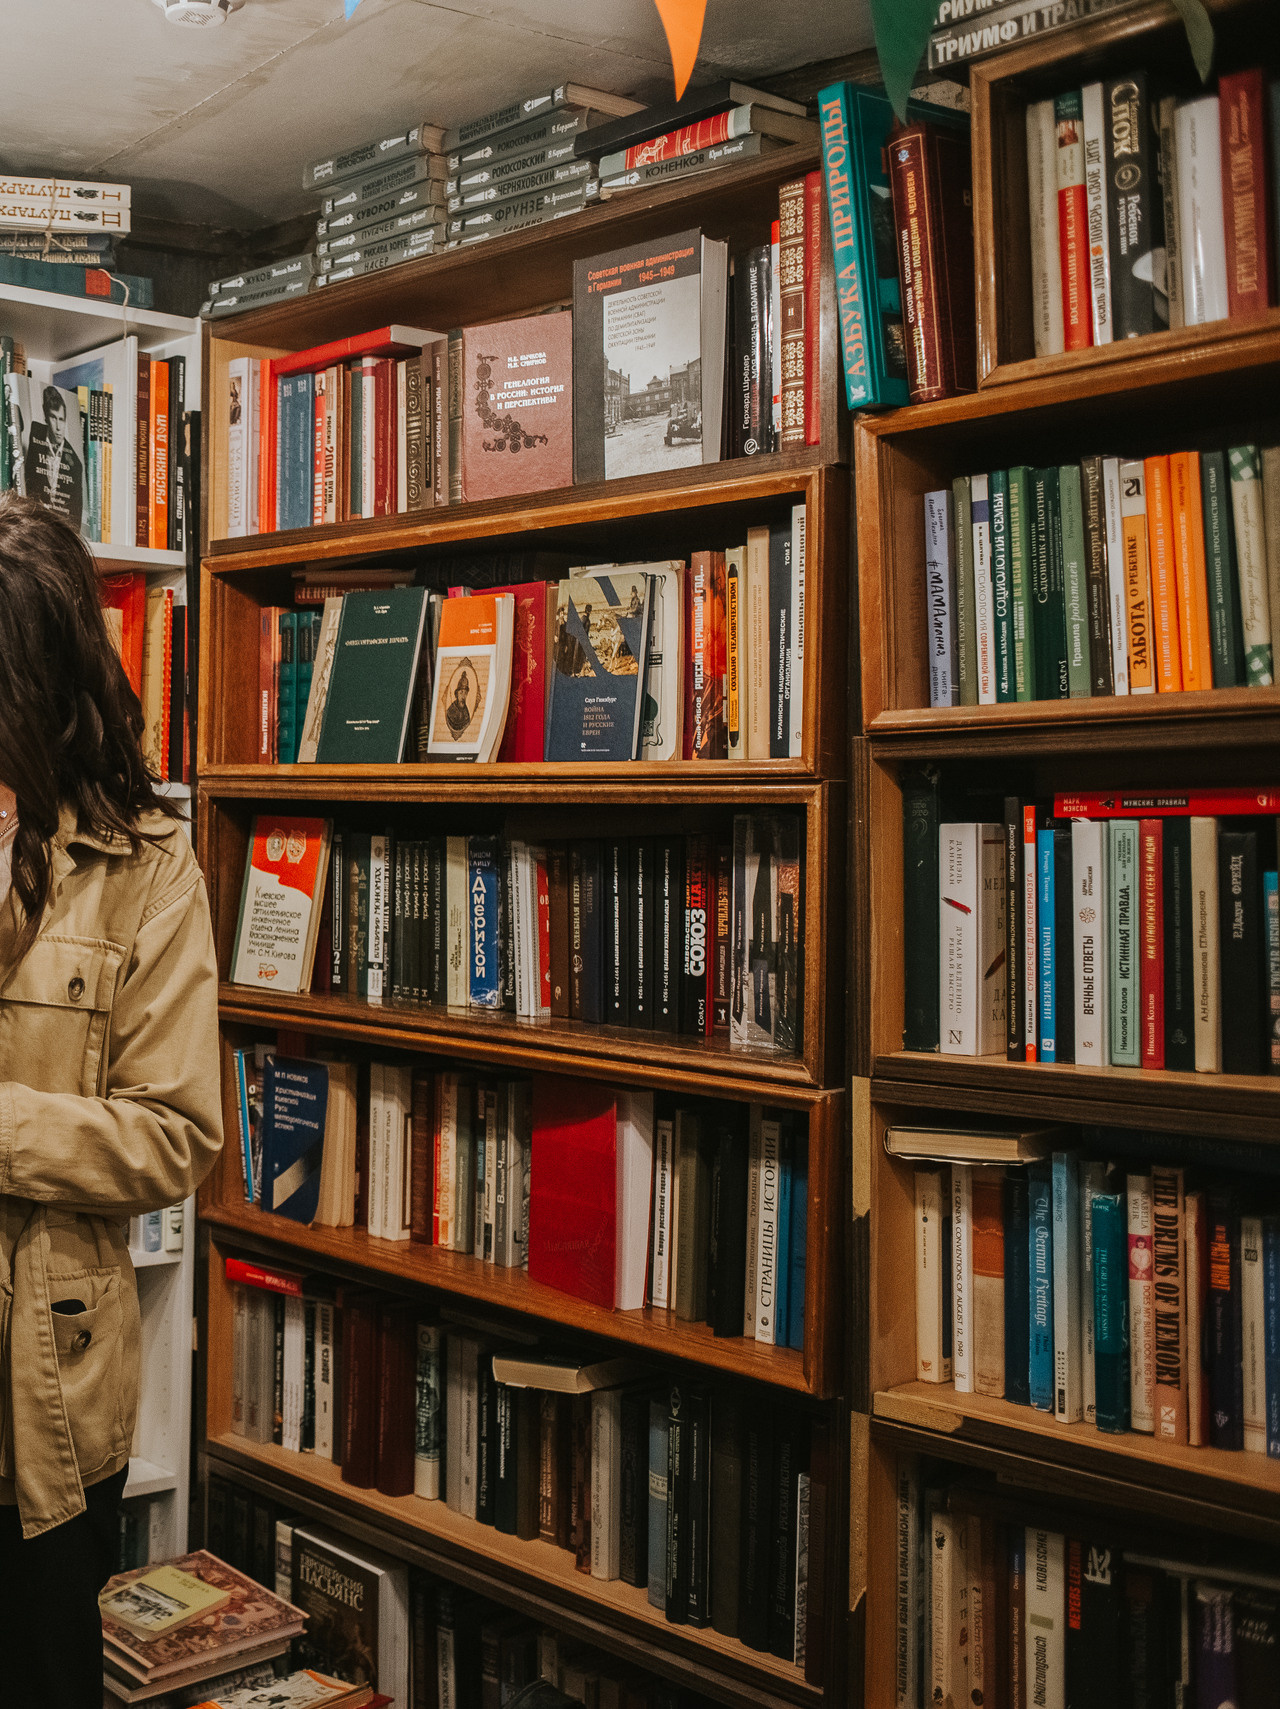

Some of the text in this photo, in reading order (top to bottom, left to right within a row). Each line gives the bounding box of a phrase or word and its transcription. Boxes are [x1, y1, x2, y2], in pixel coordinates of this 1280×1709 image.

[935, 15, 1036, 63] ТРИУМФ И
[492, 151, 546, 179] РОКОССОВСКИЙ
[497, 171, 556, 197] ЧЕРНЯХОВСКИЙ
[356, 199, 396, 221] СУВОРОВ
[494, 198, 544, 222] ФРУНЗЕ
[1065, 189, 1076, 239] ИСЛАМЕ
[822, 98, 866, 377] АЗБУКА ПРИРОДЫ
[245, 272, 271, 286] ЖУКОВ
[588, 247, 694, 281] Советская военная администрация
[900, 229, 916, 323] ОСНОВЫ ПСИХОЛОГИИ
[750, 267, 758, 313] ПОЛИТИКЕ
[1066, 252, 1079, 325] ВОСПИТАНИЕ
[750, 324, 758, 358] ЖИЗНЬ
[504, 376, 550, 389] ГЕНЕАЛОГИЯ
[750, 358, 758, 379] МОЯ
[490, 384, 564, 401] В РОССИИ: ИСТОРИЯ
[504, 395, 557, 409] ПЕРСПЕКТИВЫ
[740, 355, 751, 430] Герхард Шрёдер
[155, 414, 167, 504] РУССКИЙ ДОМ
[993, 493, 1008, 617] СОЦИОЛОГИЯ СЕМЬИ
[1208, 467, 1224, 604] ЖИЗНЕННОЕ ПРОСТРАНСТВО СЕМЬИ
[1068, 561, 1084, 667] Правила родителей
[1128, 536, 1147, 669] ЗАБОТА О РЕБЕНКЕ
[778, 609, 786, 693] НАЦИОНАЛИСТИЧЕСКИЕ
[977, 569, 989, 694] ПСИХОЛОГИЯ СОВРЕМЕННОЙ СЕМЬИ
[1145, 836, 1155, 864] ЛЮДЯМ
[374, 867, 382, 915] МОНОМАХ
[1146, 873, 1155, 890] СЕБЕ
[254, 900, 277, 908] высшее
[394, 892, 402, 916] триумф
[1146, 899, 1156, 943] ОТНОСИТЬСЯ
[251, 924, 300, 935] ордена Ленина
[690, 909, 705, 977] СОЮЗ
[1026, 872, 1034, 1034] Кавашина СУПЕРСЧЕТ ДЛЯ СУПЕРМОЗГА
[1043, 927, 1051, 1020] ПРАВИЛА ЖИЗНИ
[1147, 945, 1156, 959] КАК
[1083, 935, 1094, 1015] ВЕЧНЫЕ ОТВЕТЫ
[1146, 993, 1155, 1020] Козлов
[1146, 1022, 1155, 1055] Николай
[760, 1137, 776, 1307] СТРАНИЦЫ ИСТОРИИ
[954, 1196, 962, 1224] GENEVA
[1130, 1198, 1140, 1220] WEIR
[954, 1226, 962, 1281] CONVENTIONS
[956, 1282, 962, 1293] OF
[1153, 1174, 1181, 1390] THE DRUMS OF MEMORY
[956, 1340, 964, 1357] 1949
[1142, 1285, 1153, 1408] DOES MY BUM LOOK BIG IN THIS?
[300, 1565, 363, 1612] ПАСЬЯНС
[1068, 1586, 1080, 1629] MEYERS
